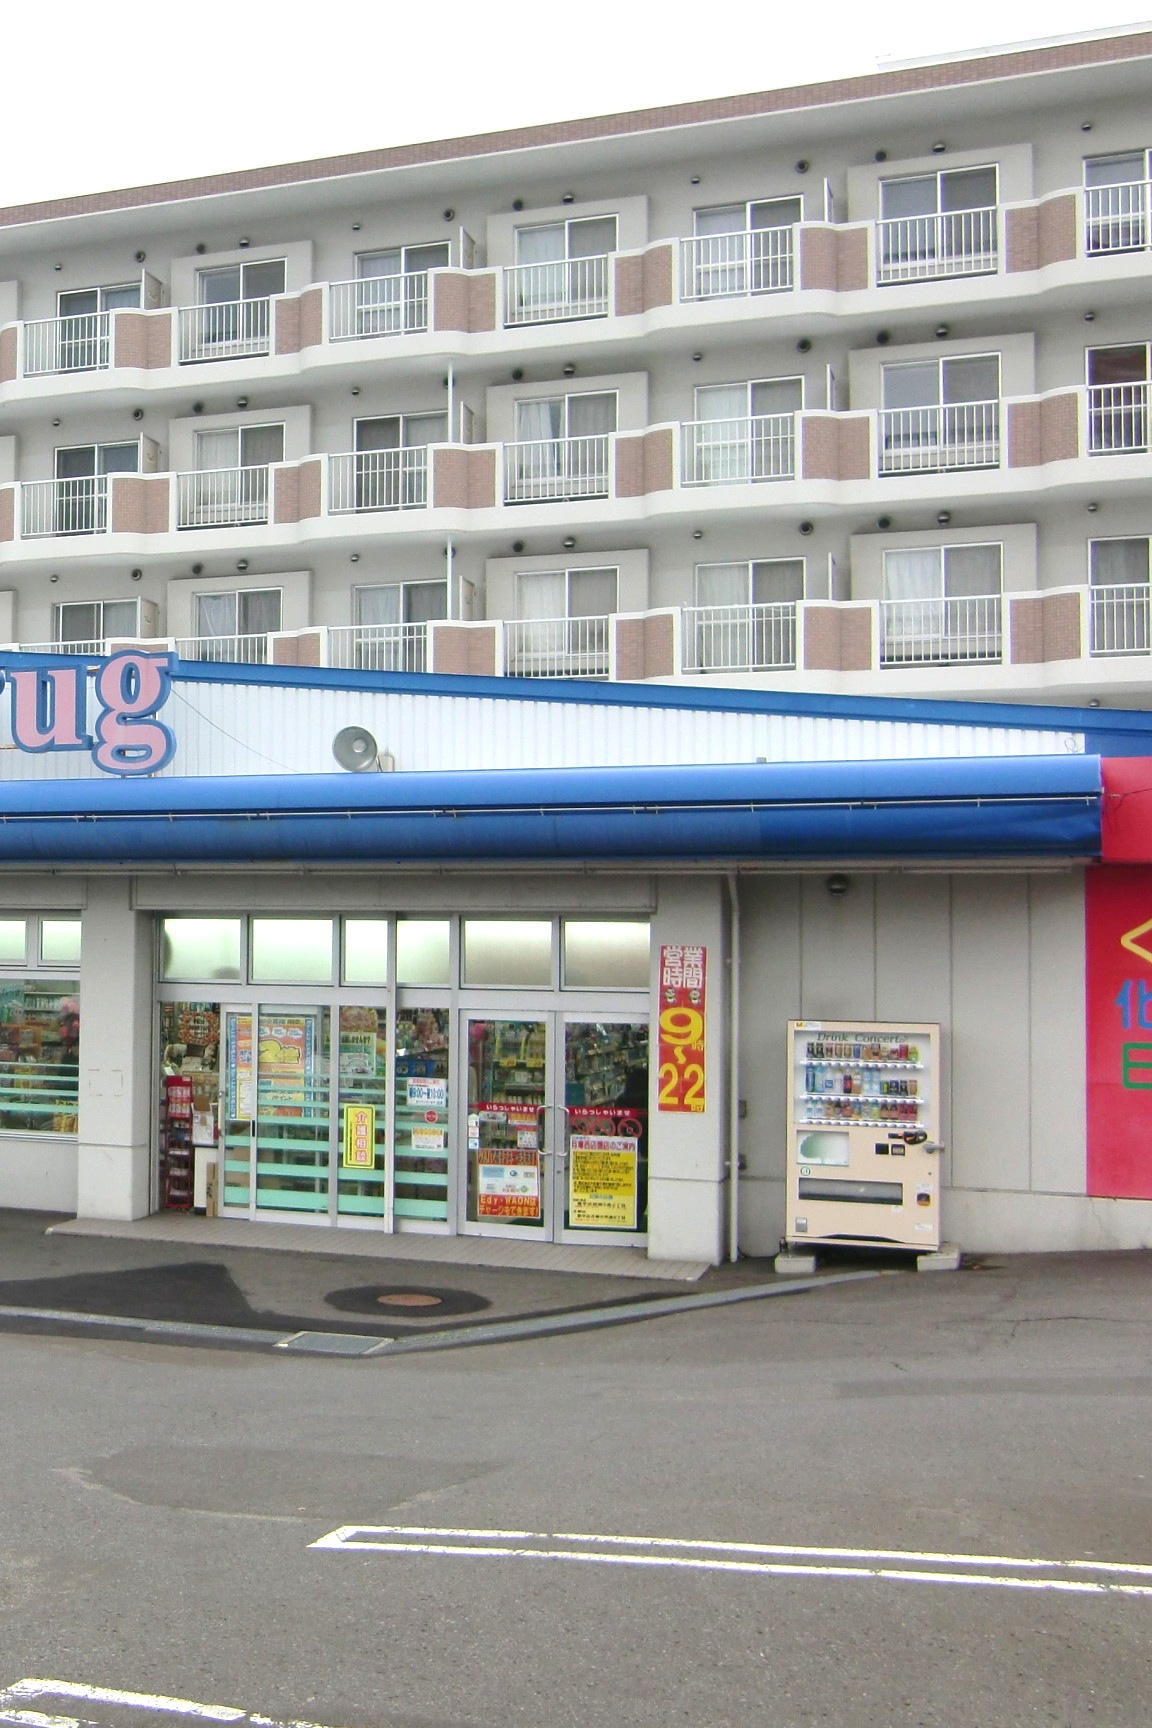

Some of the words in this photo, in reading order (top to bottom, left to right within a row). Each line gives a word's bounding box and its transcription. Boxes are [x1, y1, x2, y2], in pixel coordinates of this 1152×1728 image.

[663, 945, 704, 967] 営業
[662, 967, 703, 988] 時間
[817, 1032, 848, 1042] Drink
[486, 1104, 535, 1112] いらっしゃいませ
[574, 1107, 630, 1116] いらっしゃいませ
